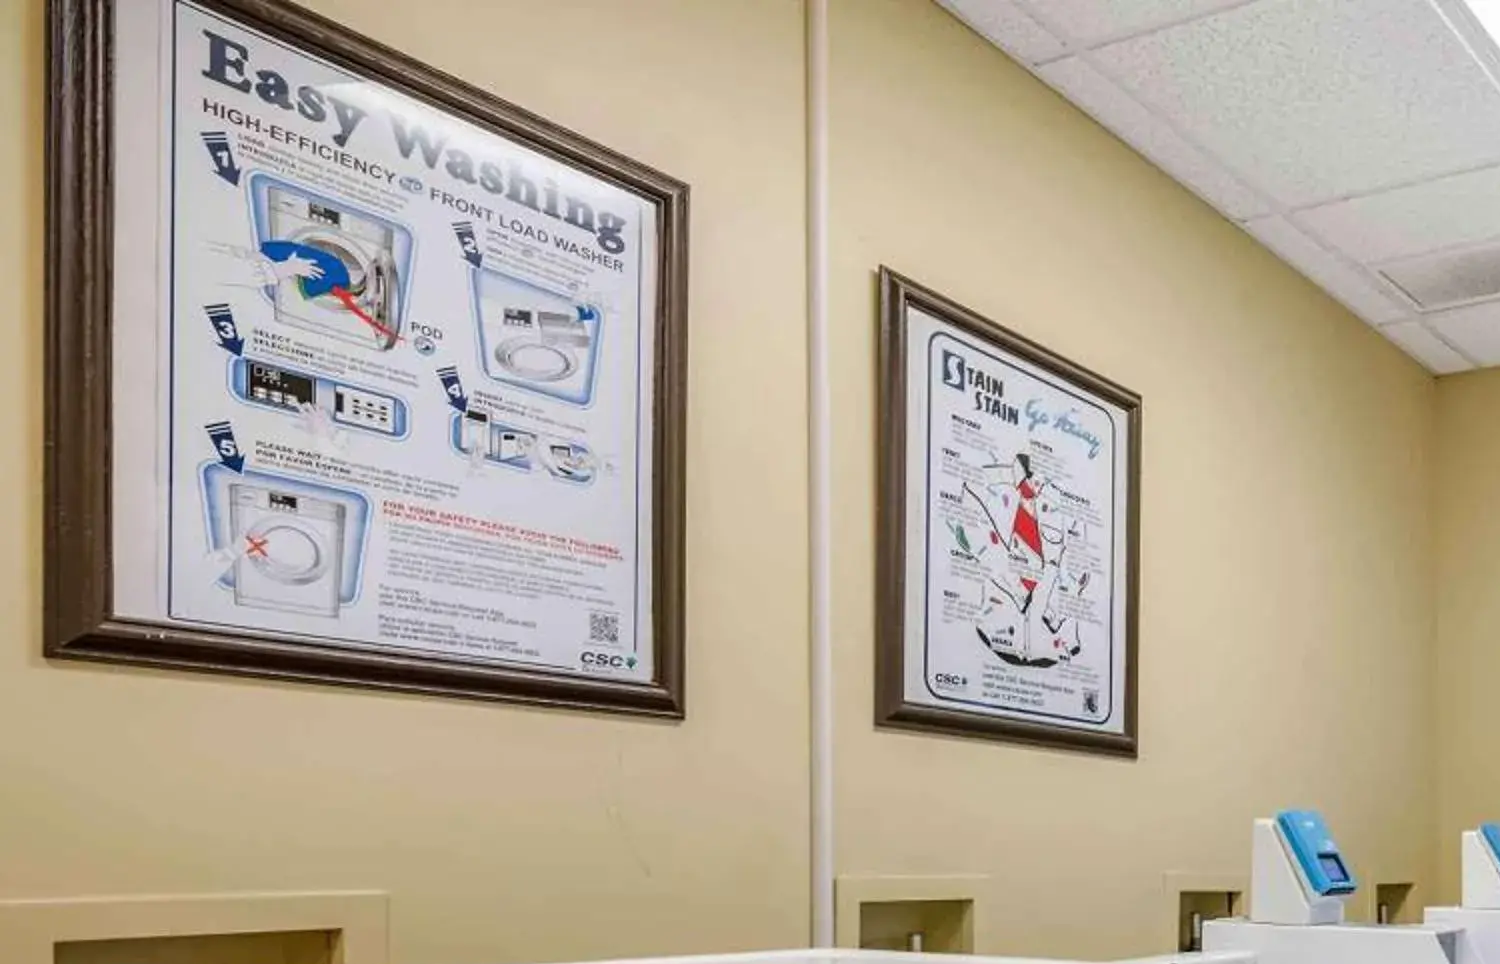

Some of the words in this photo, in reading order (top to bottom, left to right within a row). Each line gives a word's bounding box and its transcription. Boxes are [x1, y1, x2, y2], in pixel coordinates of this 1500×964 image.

[202, 29, 367, 147] Easy
[389, 110, 627, 254] Washing
[203, 98, 396, 183] HIGH-EFFICIENCY
[217, 151, 229, 167] 1
[430, 188, 493, 221] FRONT
[499, 214, 549, 244] LOAD
[553, 235, 624, 274] WASHER
[463, 237, 475, 251] 2
[219, 322, 235, 338] 3
[253, 328, 291, 343] SELECT
[410, 321, 443, 341] POD
[944, 351, 1004, 398] STAIN
[447, 383, 460, 398] 4
[975, 391, 1019, 426] STAIN
[1024, 399, 1049, 431] Go
[220, 440, 236, 456] 5
[255, 440, 297, 456] PLEASE
[409, 504, 437, 517] YOUR
[439, 510, 478, 526] SAFETY
[480, 519, 516, 533] PLEASE
[581, 651, 624, 668] CSC
[935, 673, 961, 685] CSC
